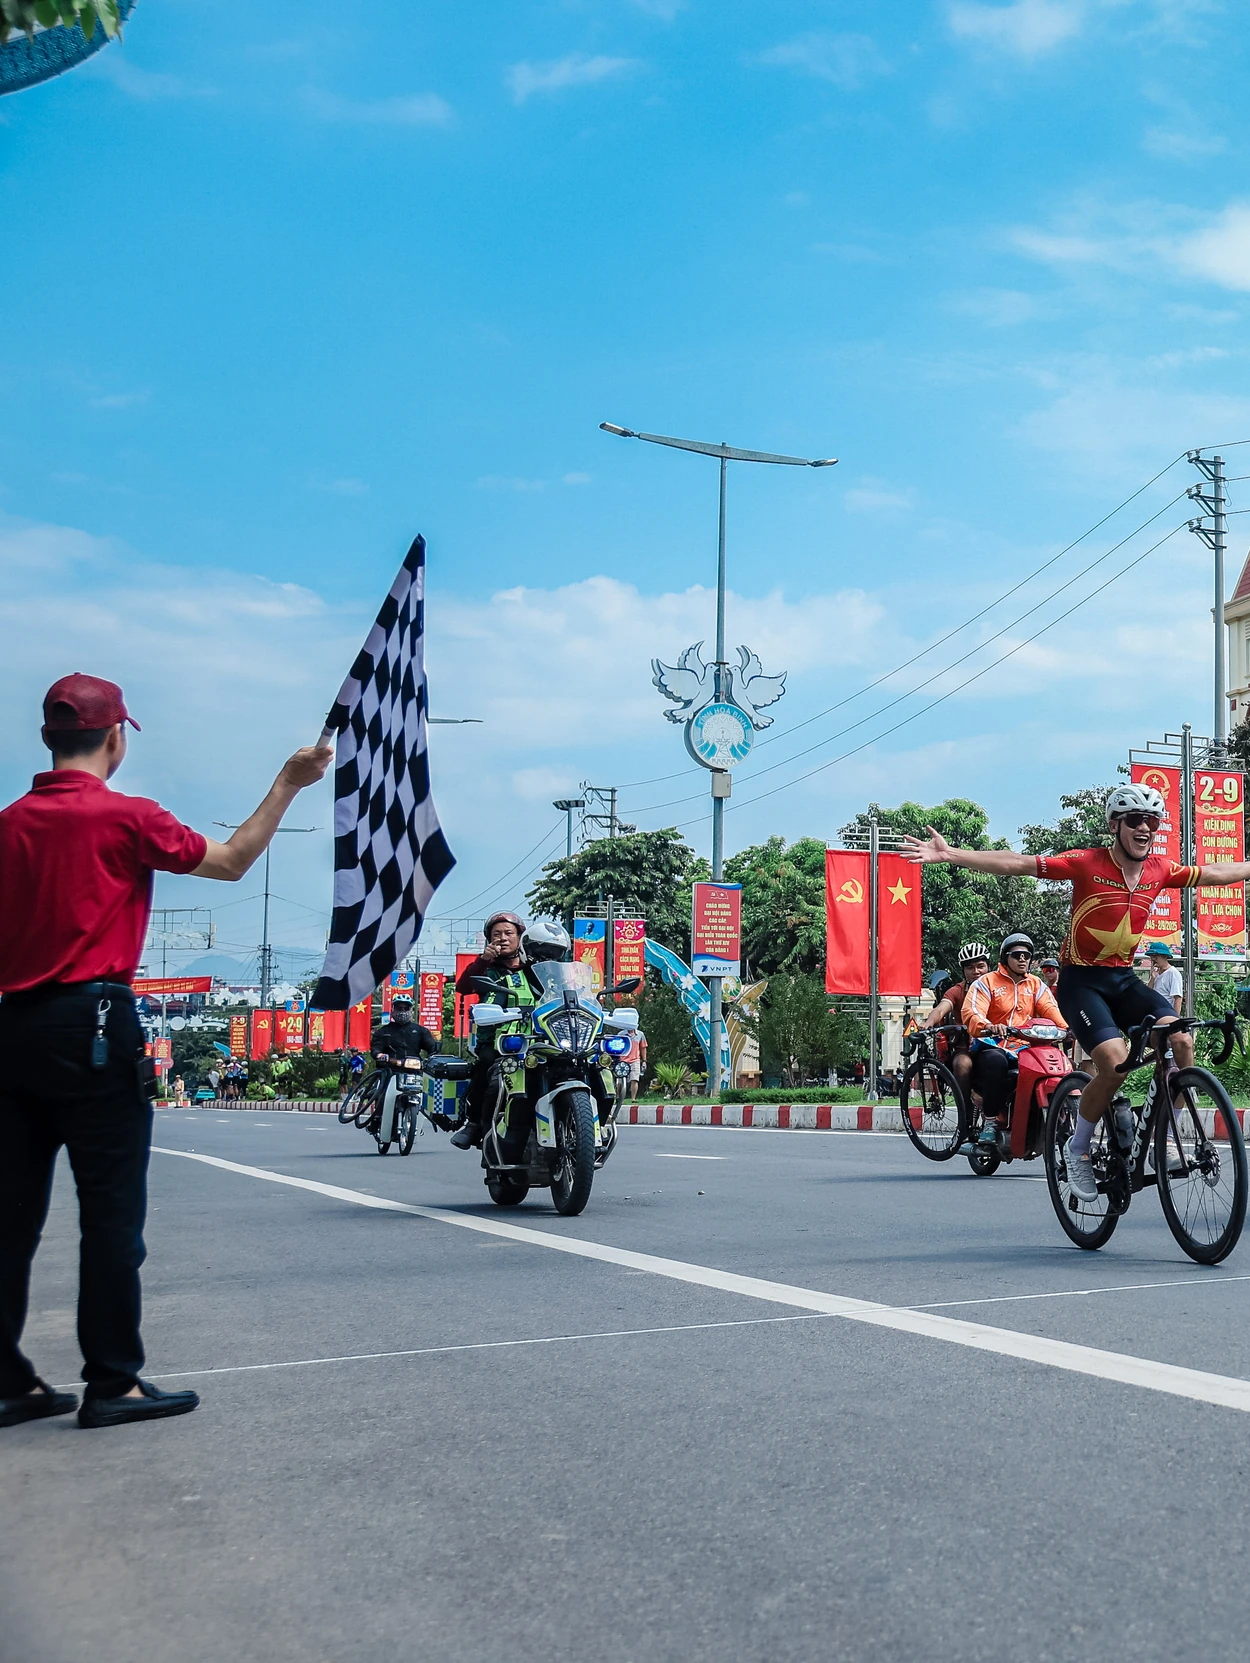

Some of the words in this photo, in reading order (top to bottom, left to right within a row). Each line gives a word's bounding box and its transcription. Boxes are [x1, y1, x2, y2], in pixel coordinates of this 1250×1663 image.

[1199, 776, 1239, 803] 2-9
[1203, 817, 1219, 831] KIÊN
[1220, 819, 1236, 833] ĐỊNH
[1202, 836, 1216, 848] CON
[1216, 834, 1238, 849] ĐƯỜNG
[1154, 881, 1160, 889] 7
[1201, 886, 1219, 898] NHÂN
[1220, 886, 1233, 899] DÂN
[1234, 888, 1243, 899] TA
[1200, 902, 1209, 915] ĐÃ
[1212, 904, 1224, 918] LỰA
[1225, 904, 1242, 919] CHỌN
